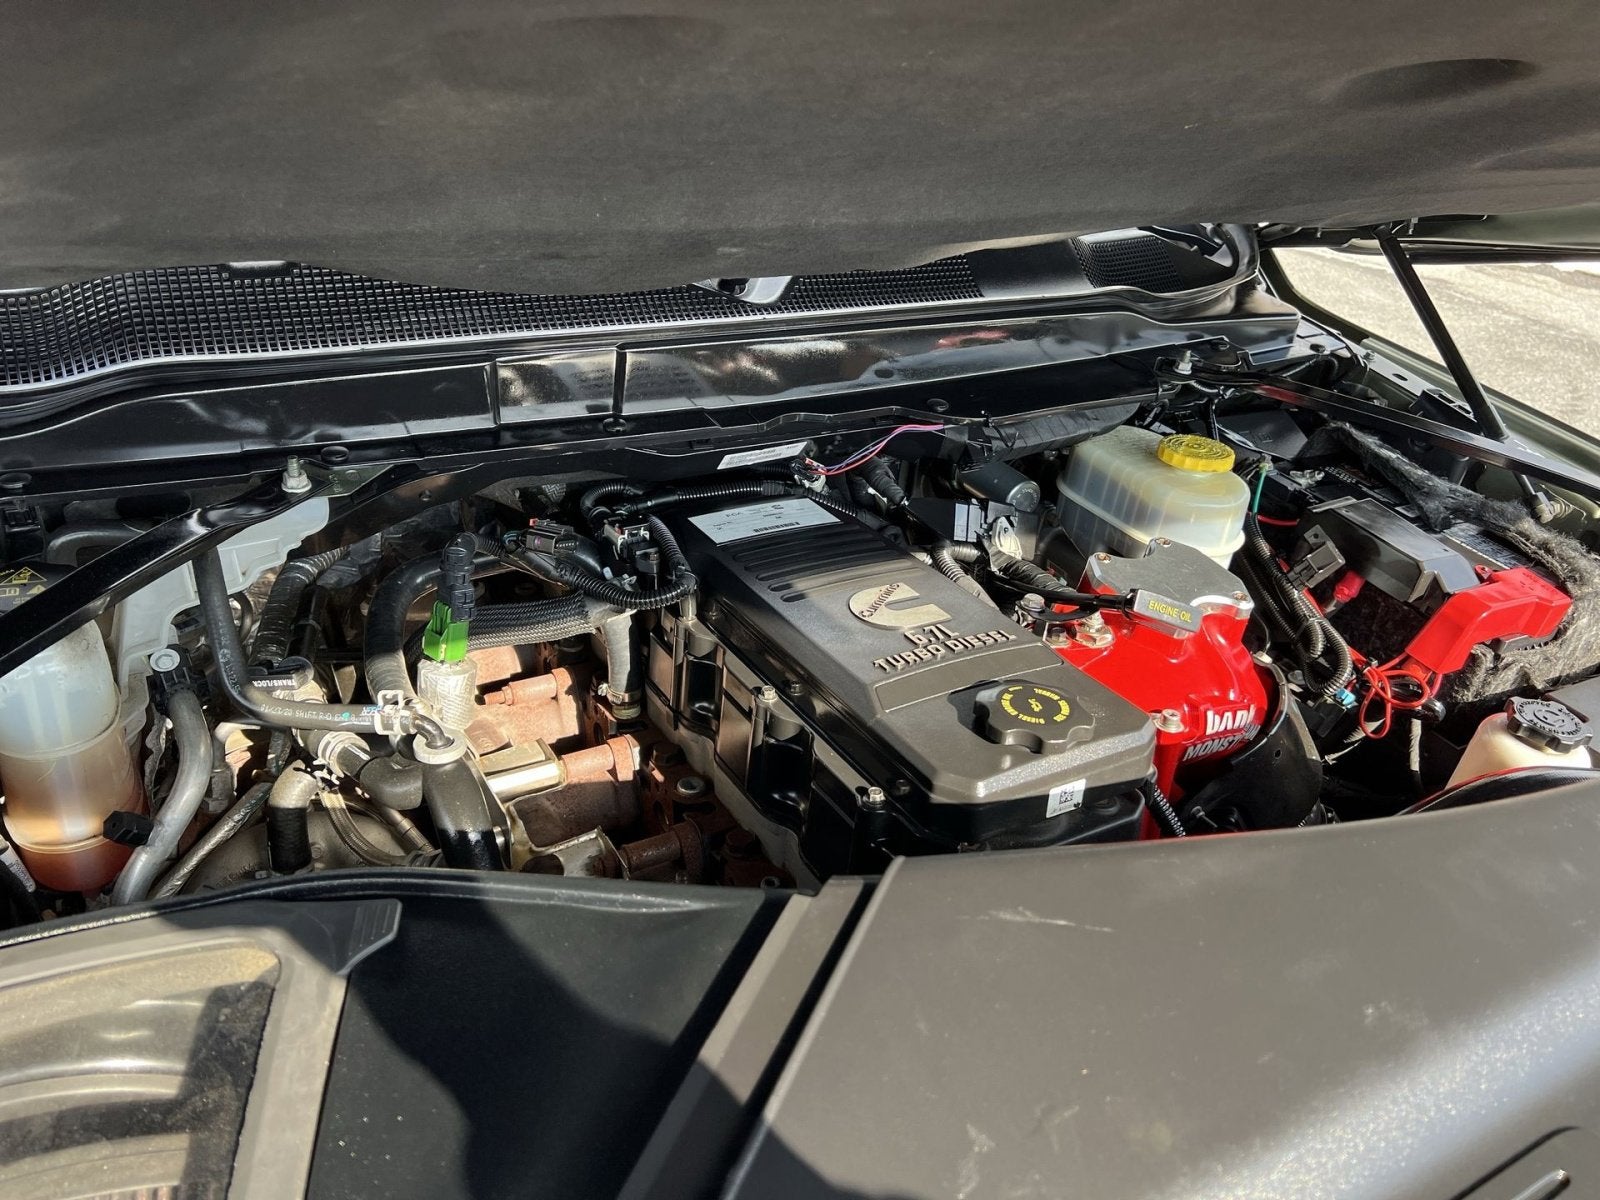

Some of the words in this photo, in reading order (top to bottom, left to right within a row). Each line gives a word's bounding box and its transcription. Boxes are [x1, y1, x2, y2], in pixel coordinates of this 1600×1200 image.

[859, 583, 900, 618] Cummins
[1148, 600, 1179, 618] ENGINE
[1180, 610, 1192, 623] OIL
[904, 623, 960, 646] 6.7L
[873, 644, 946, 673] TURBO
[944, 629, 1017, 654] DIESEL
[252, 679, 296, 688] TRANS/LOCK
